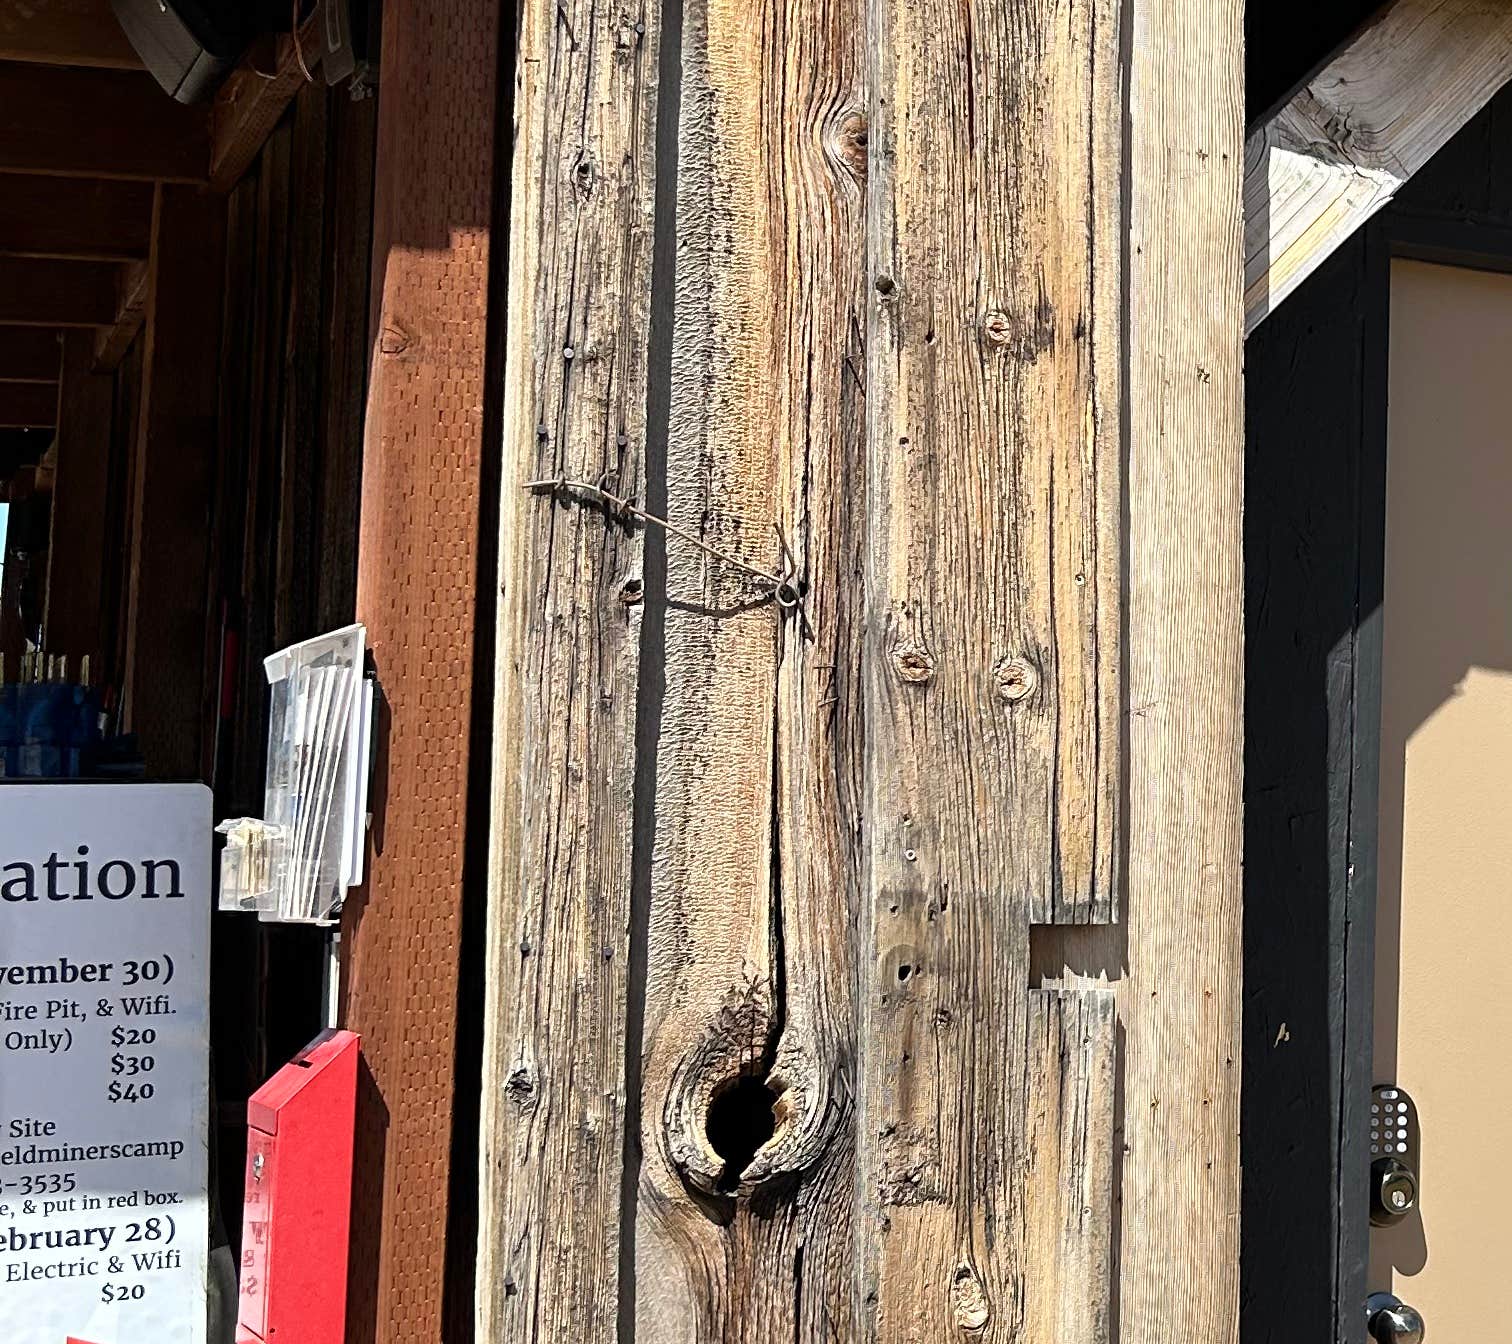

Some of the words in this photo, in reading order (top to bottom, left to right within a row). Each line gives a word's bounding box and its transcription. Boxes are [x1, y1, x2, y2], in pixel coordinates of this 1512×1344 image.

[1, 845, 185, 901] ation
[122, 954, 175, 986] 30)
[0, 1001, 38, 1021] ire
[46, 999, 87, 1022] Pit,
[96, 998, 114, 1017] &
[120, 994, 177, 1016] Wifi.
[5, 1028, 73, 1053] Only)
[111, 1025, 157, 1047] $20
[111, 1053, 155, 1075] $30
[108, 1080, 155, 1103] $40
[9, 1118, 57, 1138] Site
[1, 1140, 184, 1165] eldminerscamp
[0, 1172, 77, 1195] -3535
[22, 1199, 38, 1214] &
[43, 1199, 77, 1217] put
[82, 1194, 101, 1210] in
[107, 1191, 139, 1208] red
[144, 1190, 184, 1206] box.
[125, 1214, 176, 1244] 28)
[6, 1257, 100, 1283] Electric
[107, 1255, 125, 1274] &
[131, 1249, 182, 1271] Wifi
[101, 1282, 146, 1304] $20
